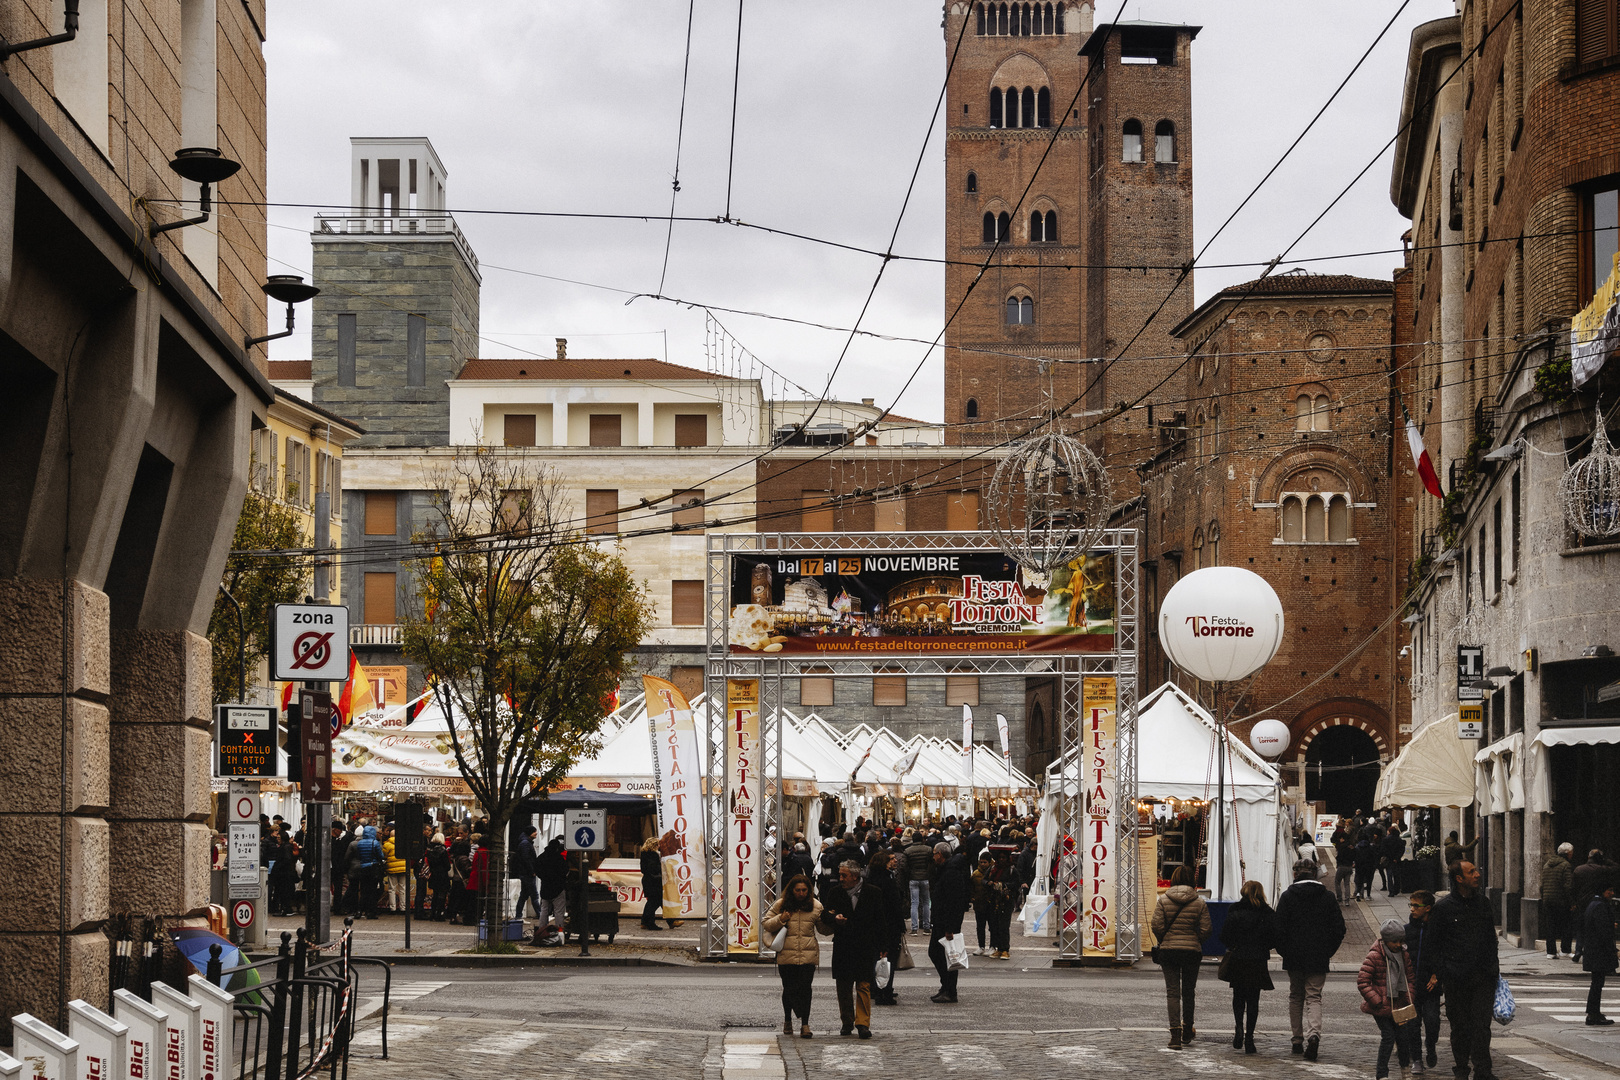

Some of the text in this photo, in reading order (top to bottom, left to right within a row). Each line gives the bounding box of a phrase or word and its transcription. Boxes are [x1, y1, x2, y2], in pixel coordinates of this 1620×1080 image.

[778, 556, 960, 573] Dal 17 al 25 NOVEMBRE
[963, 576, 1024, 602] FESTA
[292, 612, 334, 625] zona
[1211, 616, 1238, 626] Festa
[975, 624, 1022, 632] CREMONA
[1185, 616, 1254, 638] Torrone
[816, 637, 1028, 653] www.festadeltorronecremona.it
[1460, 650, 1480, 674] T
[1461, 710, 1480, 719] LOTTO
[221, 745, 270, 754] CONTROLLO
[734, 710, 752, 800] FESTA
[1090, 708, 1108, 800] FESTA
[227, 756, 265, 764] IN ATTO
[383, 777, 426, 785] SPECIALITÀ
[627, 783, 655, 791] QUARA
[239, 909, 250, 919] 30
[130, 1040, 143, 1079] Bici
